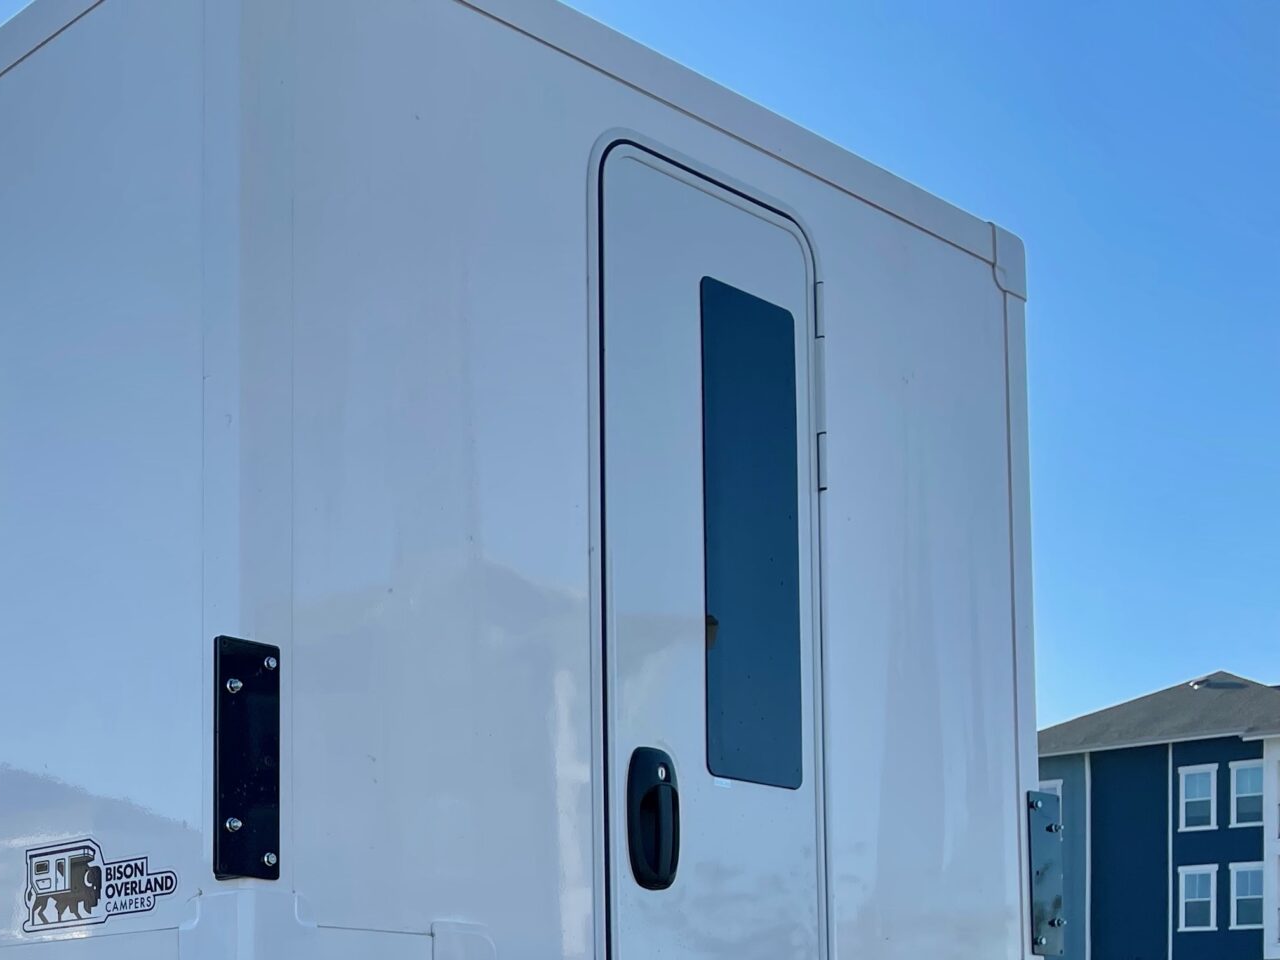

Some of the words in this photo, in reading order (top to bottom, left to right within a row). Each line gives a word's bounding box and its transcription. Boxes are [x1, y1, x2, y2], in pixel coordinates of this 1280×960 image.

[105, 861, 144, 882] BISON
[105, 875, 174, 899] OVERLAND
[105, 896, 152, 912] CAMPERS
